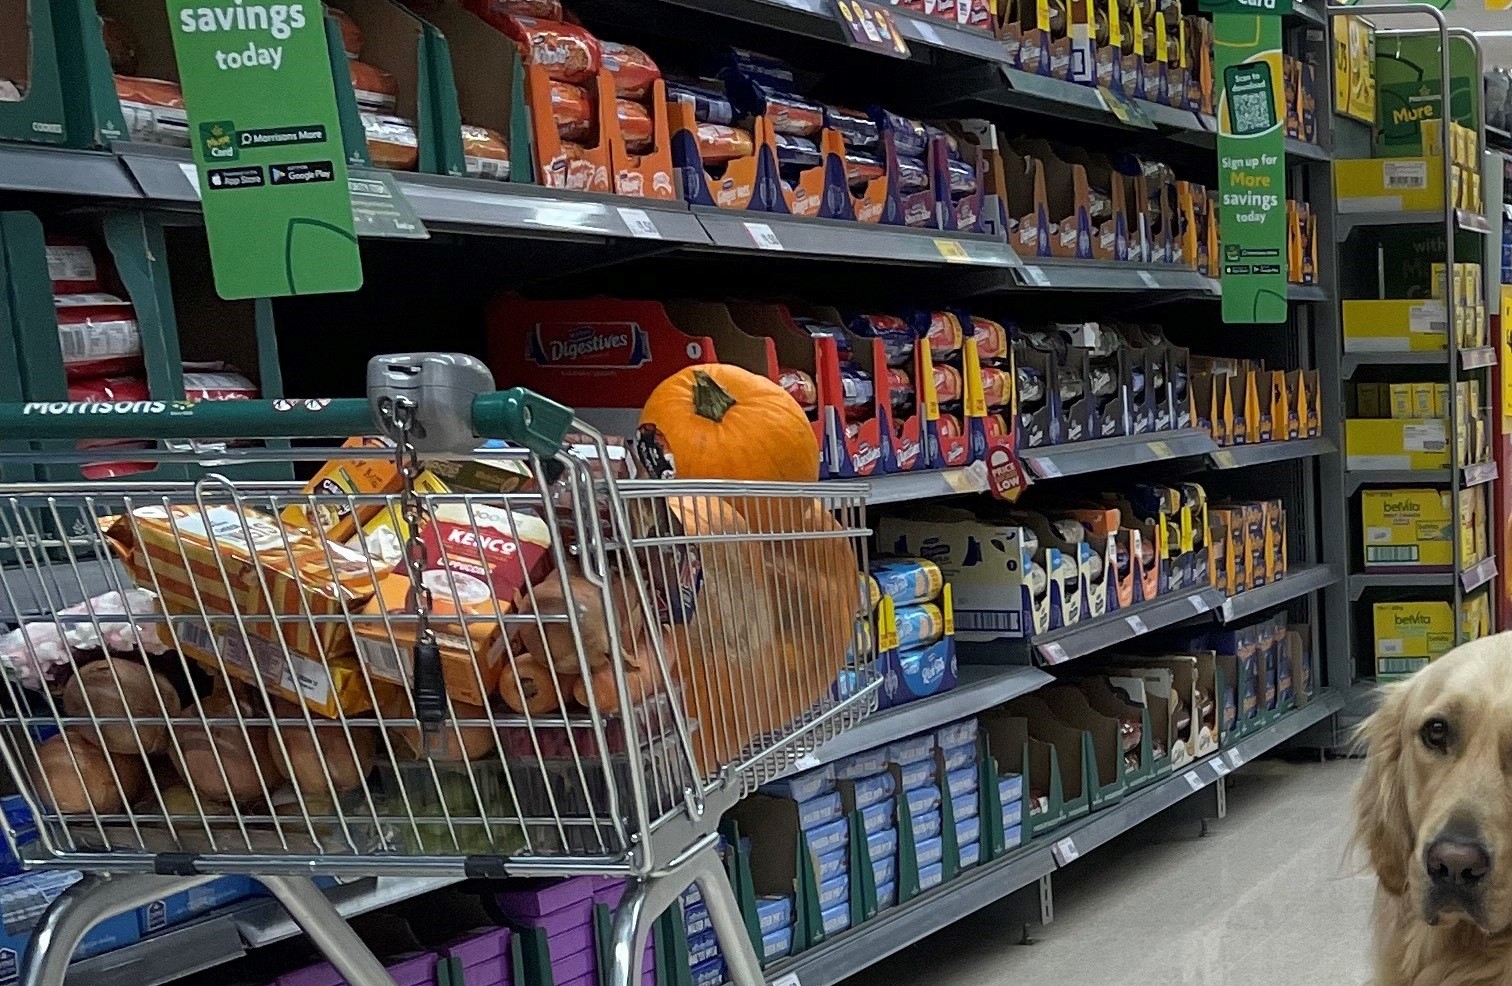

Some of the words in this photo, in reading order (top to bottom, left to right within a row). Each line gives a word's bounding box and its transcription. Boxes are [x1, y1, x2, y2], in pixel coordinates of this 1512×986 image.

[180, 0, 306, 39] savings
[215, 42, 283, 71] today
[1393, 104, 1433, 125] More
[1221, 157, 1244, 169] Sign
[1245, 157, 1259, 169] up
[1261, 154, 1277, 166] for
[1230, 172, 1271, 188] More
[1222, 192, 1278, 213] savings
[1235, 211, 1267, 225] today
[551, 333, 629, 362] Digestives
[996, 476, 1021, 493] LOW
[447, 528, 518, 557] KENCO
